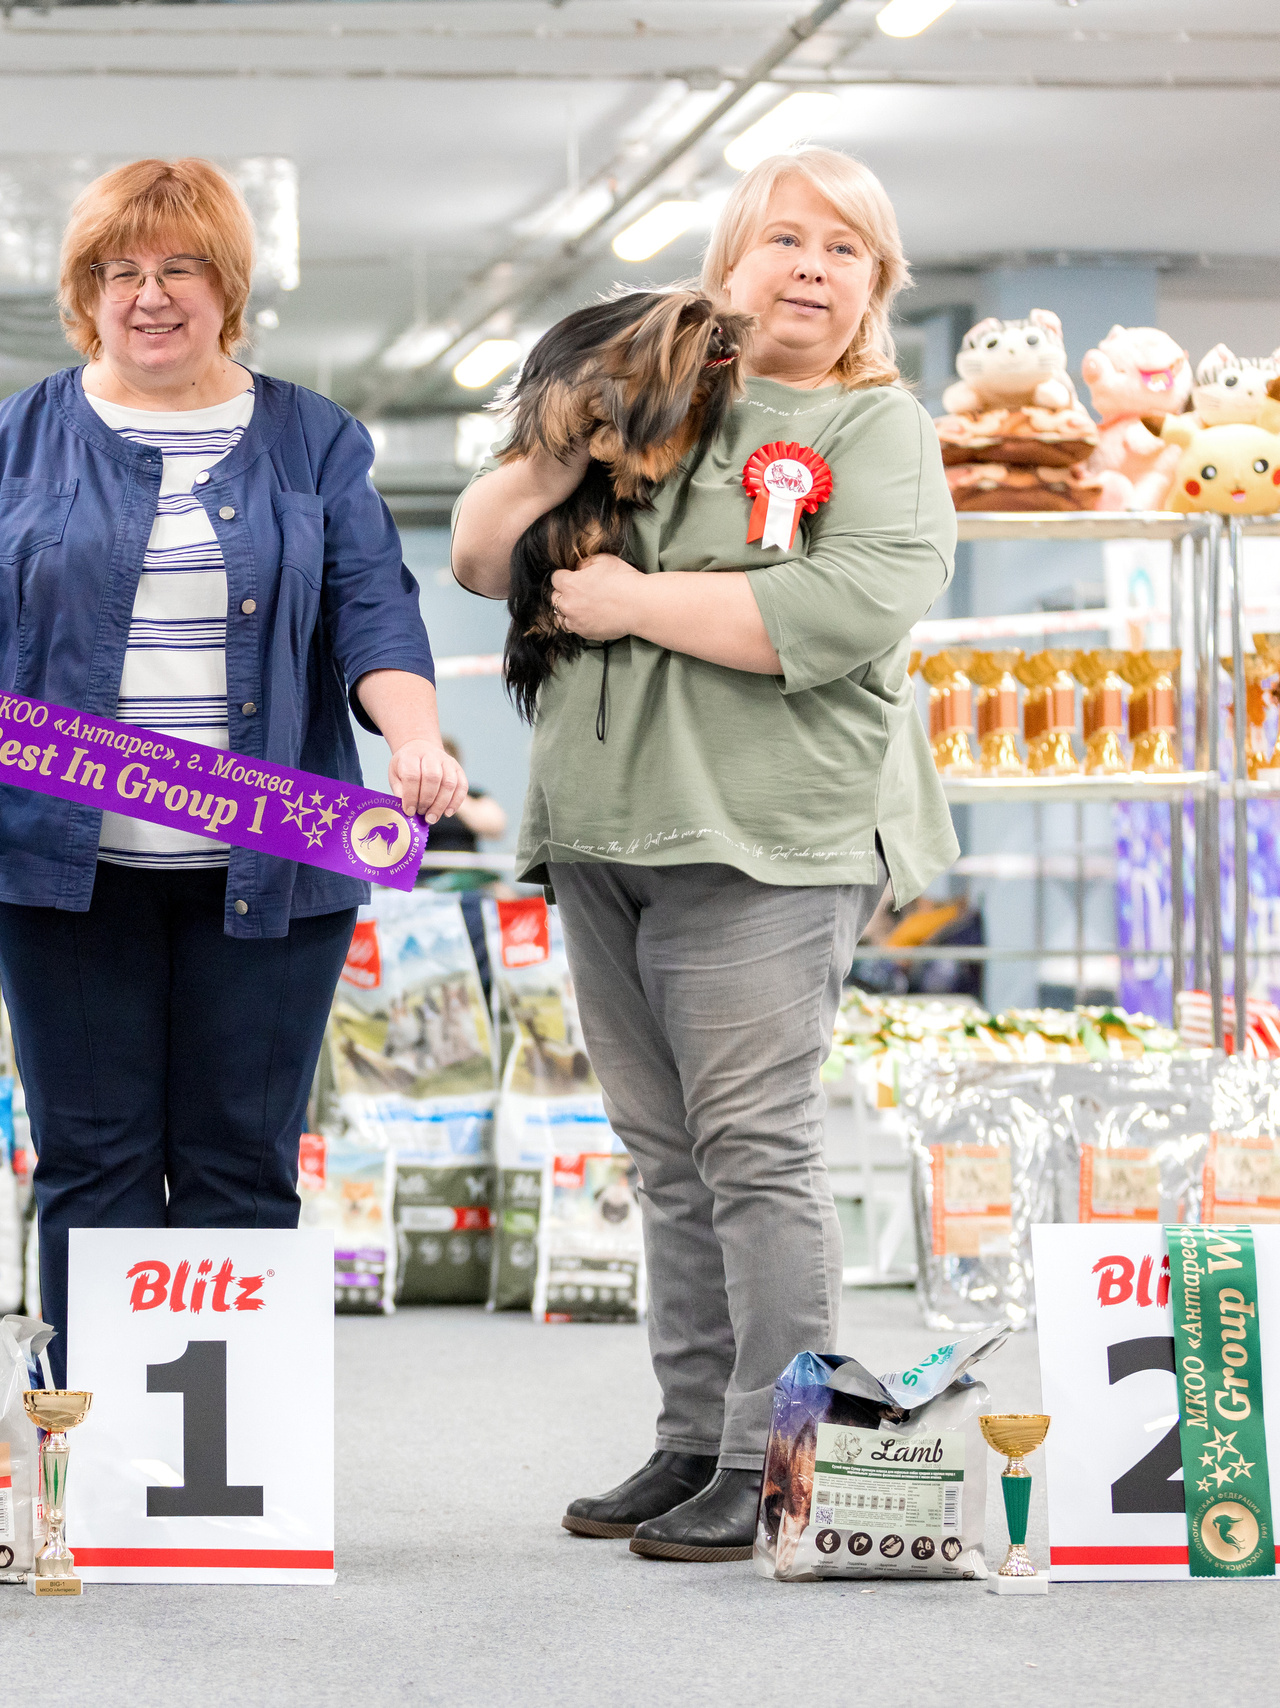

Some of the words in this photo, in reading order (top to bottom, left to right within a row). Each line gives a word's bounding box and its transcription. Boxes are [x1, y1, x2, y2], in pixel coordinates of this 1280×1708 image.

[53, 715, 180, 769] «Антарес»,
[187, 753, 203, 771] г.
[208, 754, 294, 796] Москва
[60, 747, 106, 790] In
[116, 762, 238, 833] Group
[246, 795, 267, 834] 1
[341, 810, 357, 864] РОССИЙСКАЯ
[389, 837, 420, 875] ФЕДЕРАЦИЯ
[364, 867, 380, 876] 1991
[643, 832, 665, 850] Just
[770, 845, 798, 861] Just
[1091, 1253, 1171, 1310] Bli
[1215, 1287, 1256, 1421] Group
[1106, 1335, 1187, 1514] 2
[1186, 1355, 1208, 1430] МКОО
[146, 1340, 264, 1517] 1
[871, 1438, 943, 1463] Lamb
[1218, 1492, 1261, 1514] ФЕДЕРАЦИЯ
